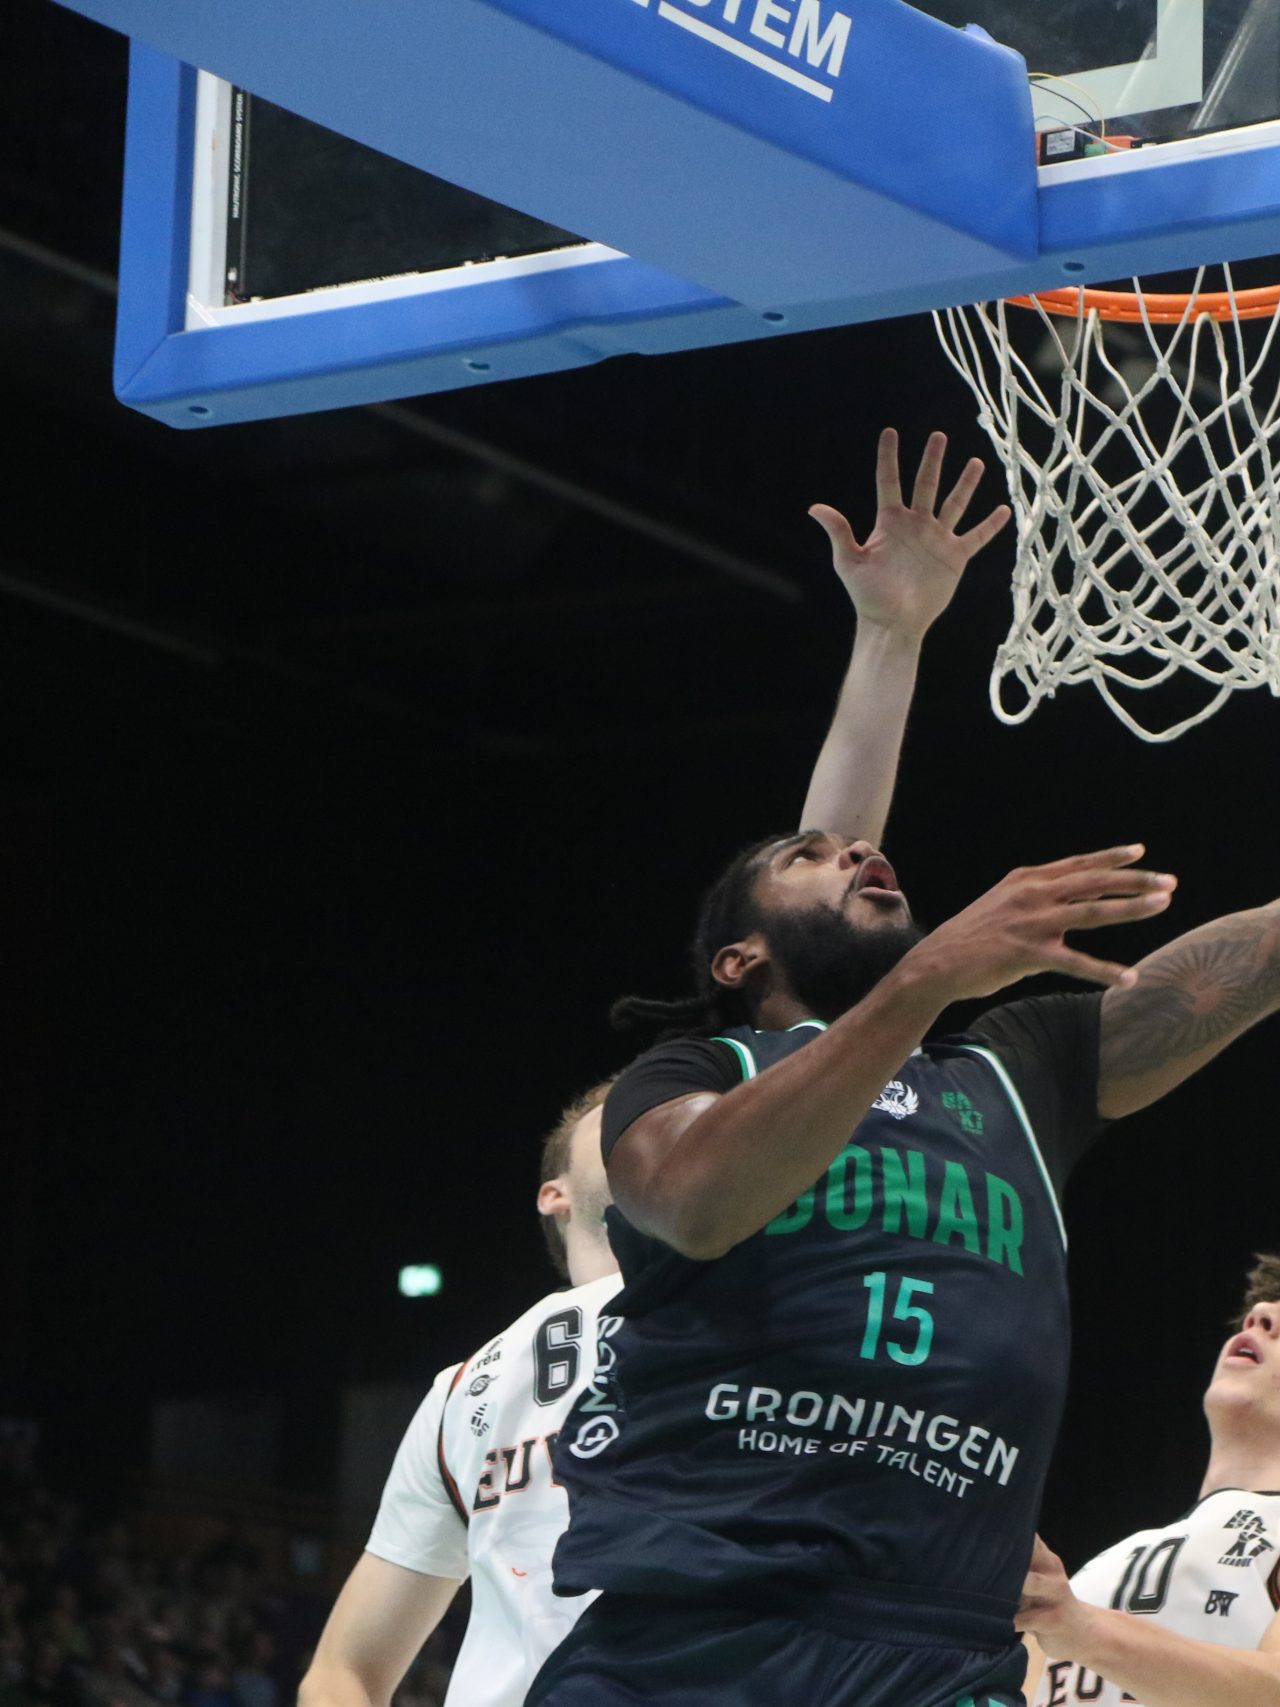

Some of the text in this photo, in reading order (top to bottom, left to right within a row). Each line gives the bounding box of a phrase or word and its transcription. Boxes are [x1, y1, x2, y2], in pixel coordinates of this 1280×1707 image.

[533, 1306, 583, 1407] 6
[860, 1272, 934, 1366] 15
[705, 1383, 1019, 1486] GRONINGEN
[738, 1429, 822, 1456] HOME
[877, 1444, 974, 1498] TALENT
[1109, 1534, 1190, 1615] 10
